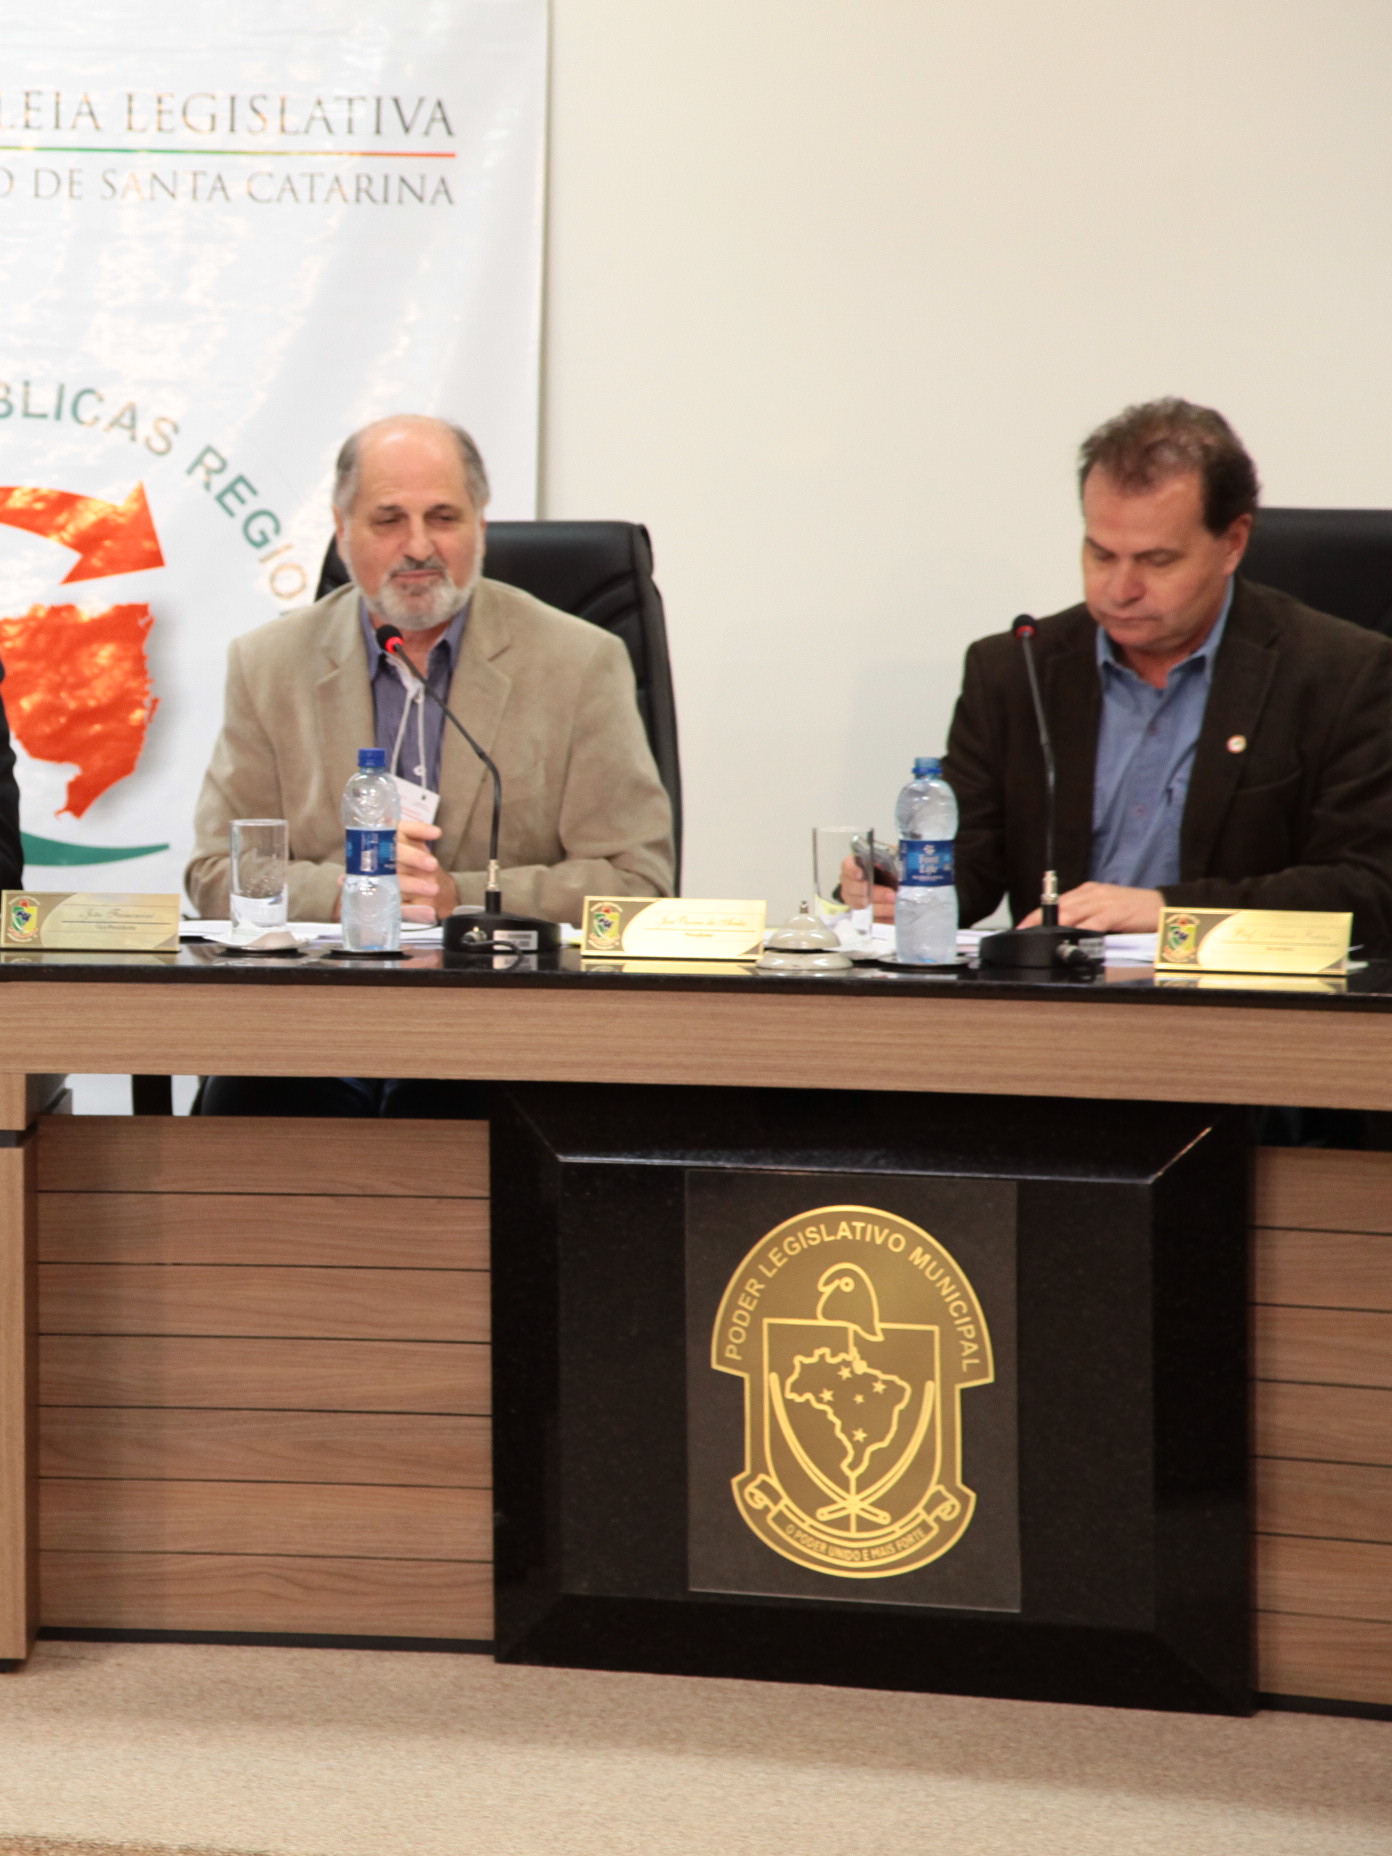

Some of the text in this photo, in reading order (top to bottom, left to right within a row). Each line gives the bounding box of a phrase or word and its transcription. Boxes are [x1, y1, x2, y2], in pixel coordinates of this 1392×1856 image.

[126, 92, 455, 137] LEGISLATIVA
[33, 167, 84, 200] DE
[100, 168, 232, 202] SANTA
[246, 171, 455, 206] CATARINA
[185, 444, 309, 602] REGIO
[724, 1220, 981, 1373] PODER LEGISLATIVO MUNICIPAL
